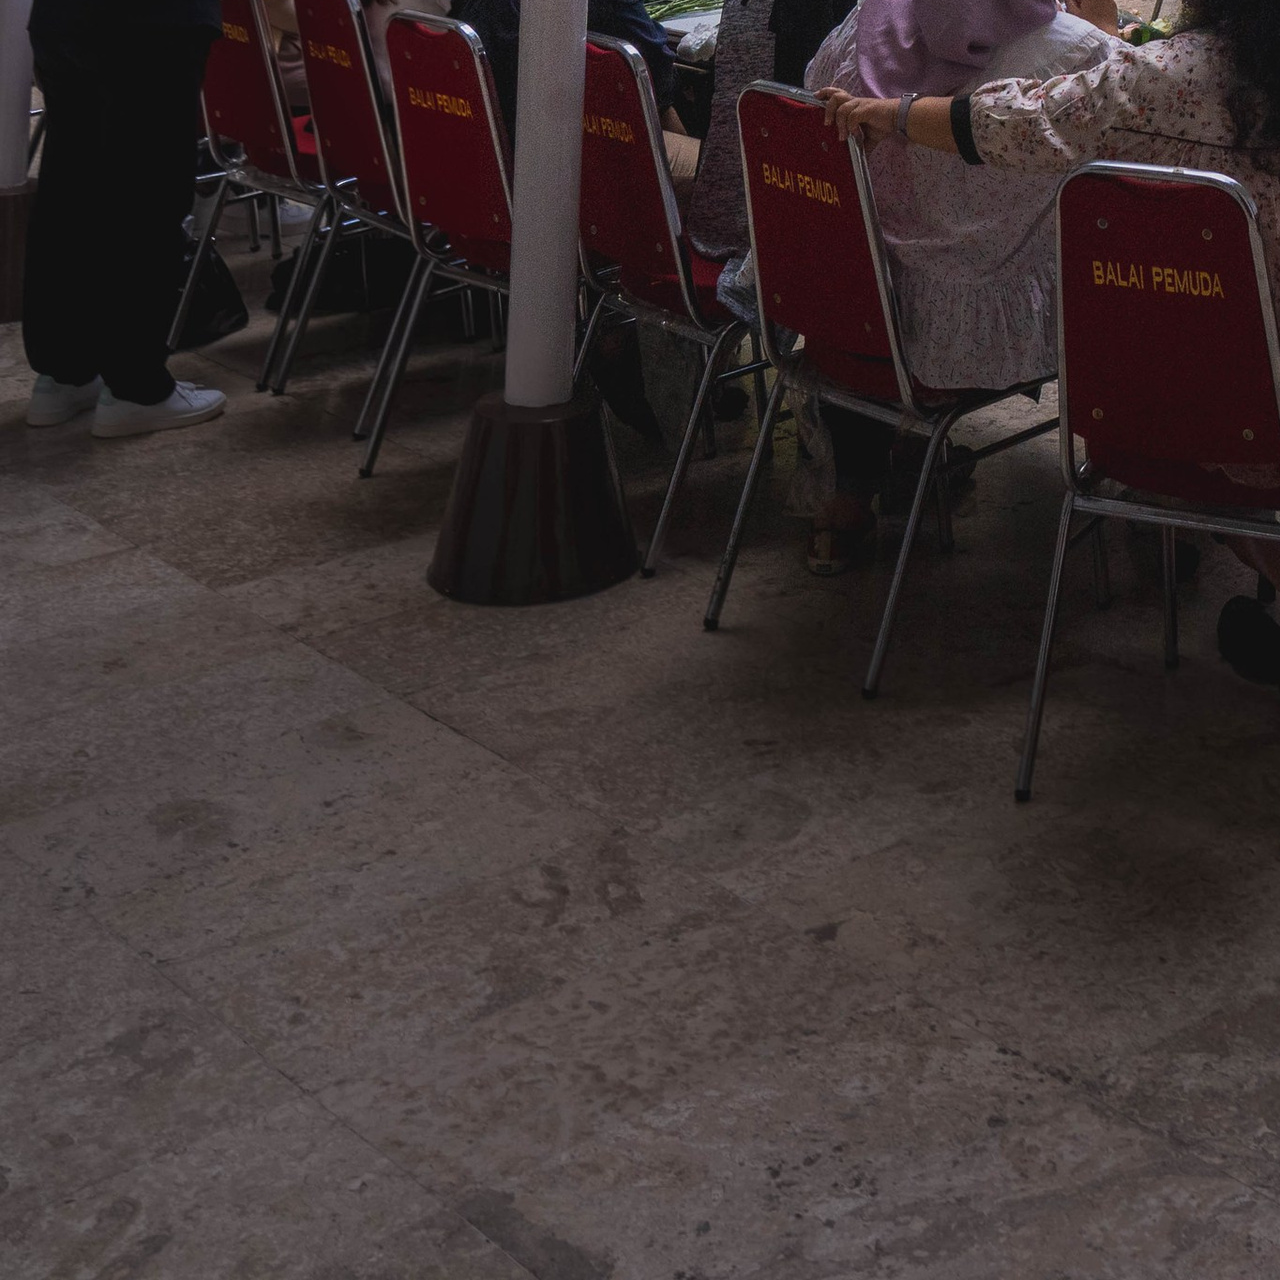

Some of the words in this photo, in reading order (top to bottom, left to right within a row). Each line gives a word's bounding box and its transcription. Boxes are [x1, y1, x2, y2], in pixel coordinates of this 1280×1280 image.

[583, 113, 601, 136] ALAI
[762, 162, 795, 193] BALAI
[797, 173, 841, 208] PEMUDA
[1092, 259, 1145, 290] BALAI
[1151, 265, 1225, 299] PEMUDA
